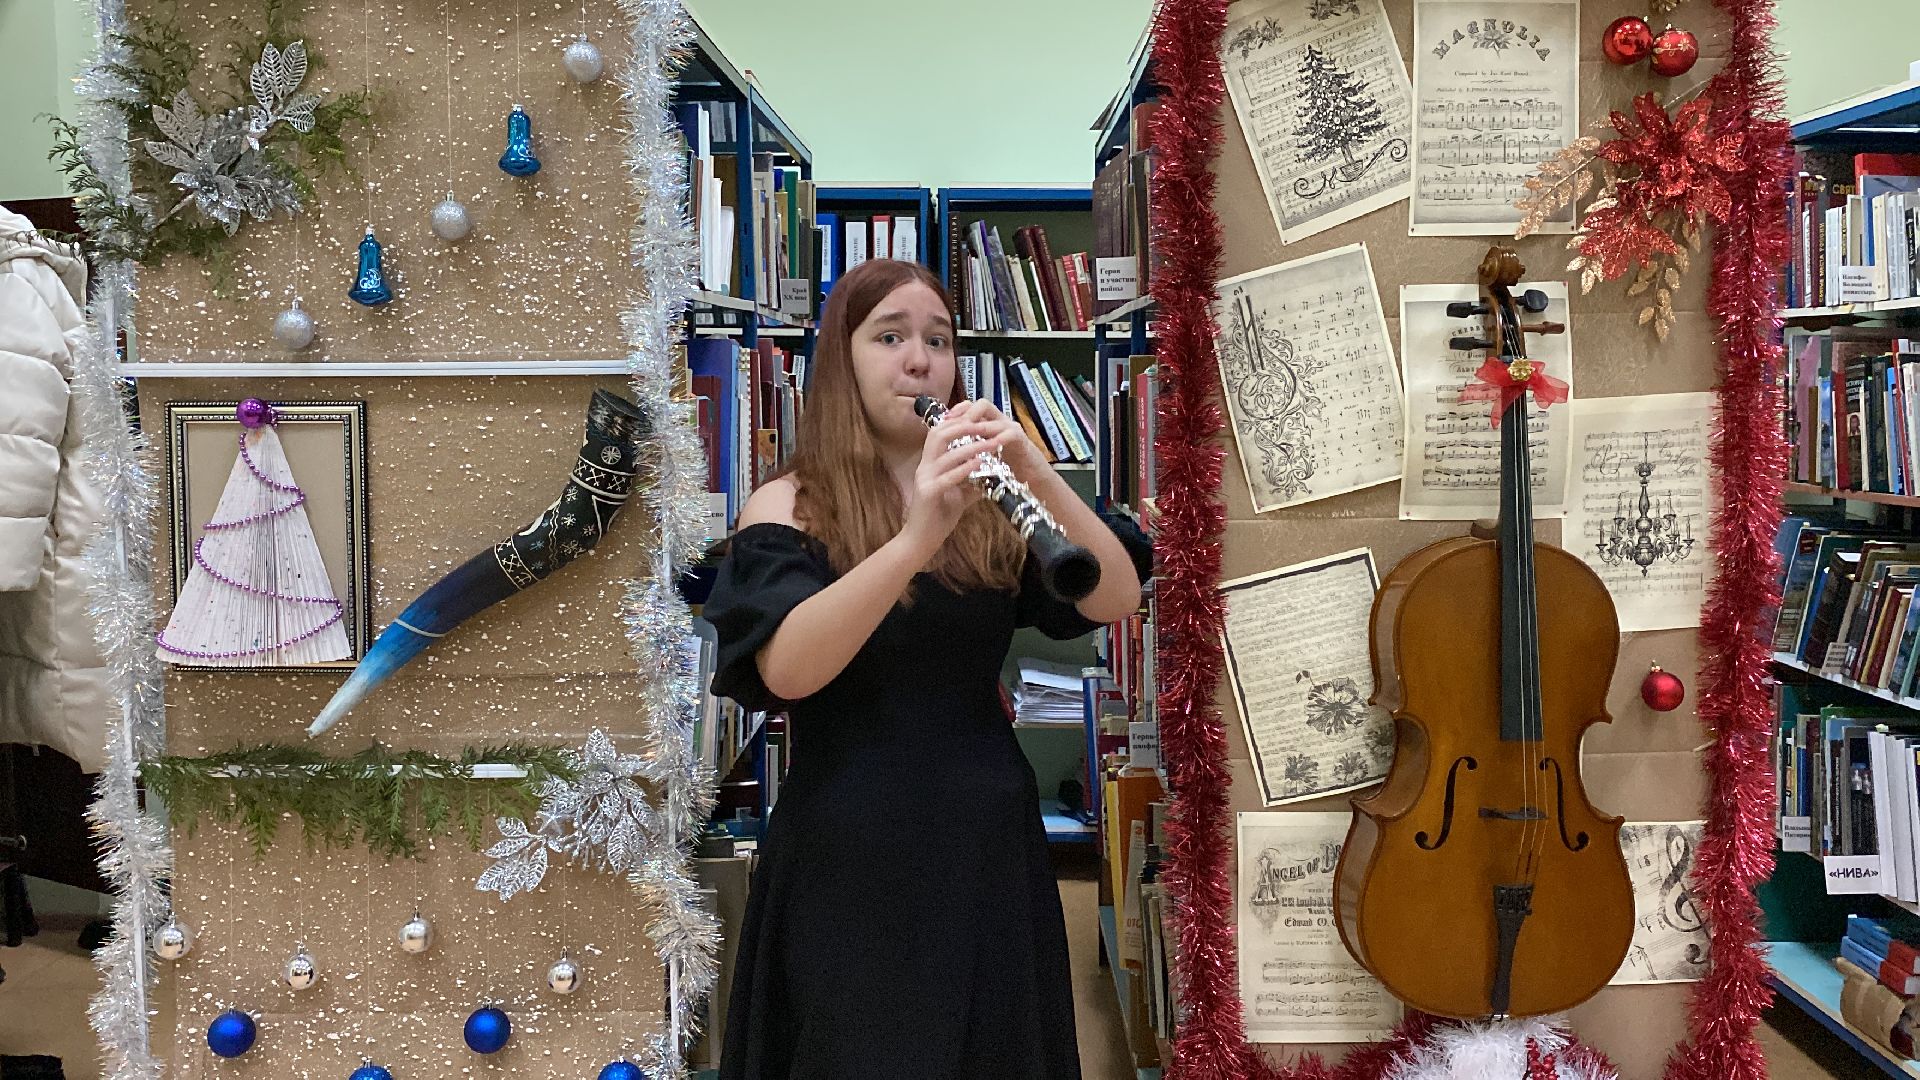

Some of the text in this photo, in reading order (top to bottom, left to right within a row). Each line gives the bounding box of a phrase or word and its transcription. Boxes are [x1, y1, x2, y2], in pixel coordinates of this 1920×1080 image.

[1432, 18, 1551, 61] MAGNOLIA
[1832, 184, 1856, 195] СВЯТ
[1052, 434, 1065, 455] АРХИВ
[1132, 742, 1159, 750] панфи
[1251, 843, 1342, 906] ANGEL OF DR
[1828, 867, 1879, 879] «НИВА»
[1284, 917, 1313, 927] Edward
